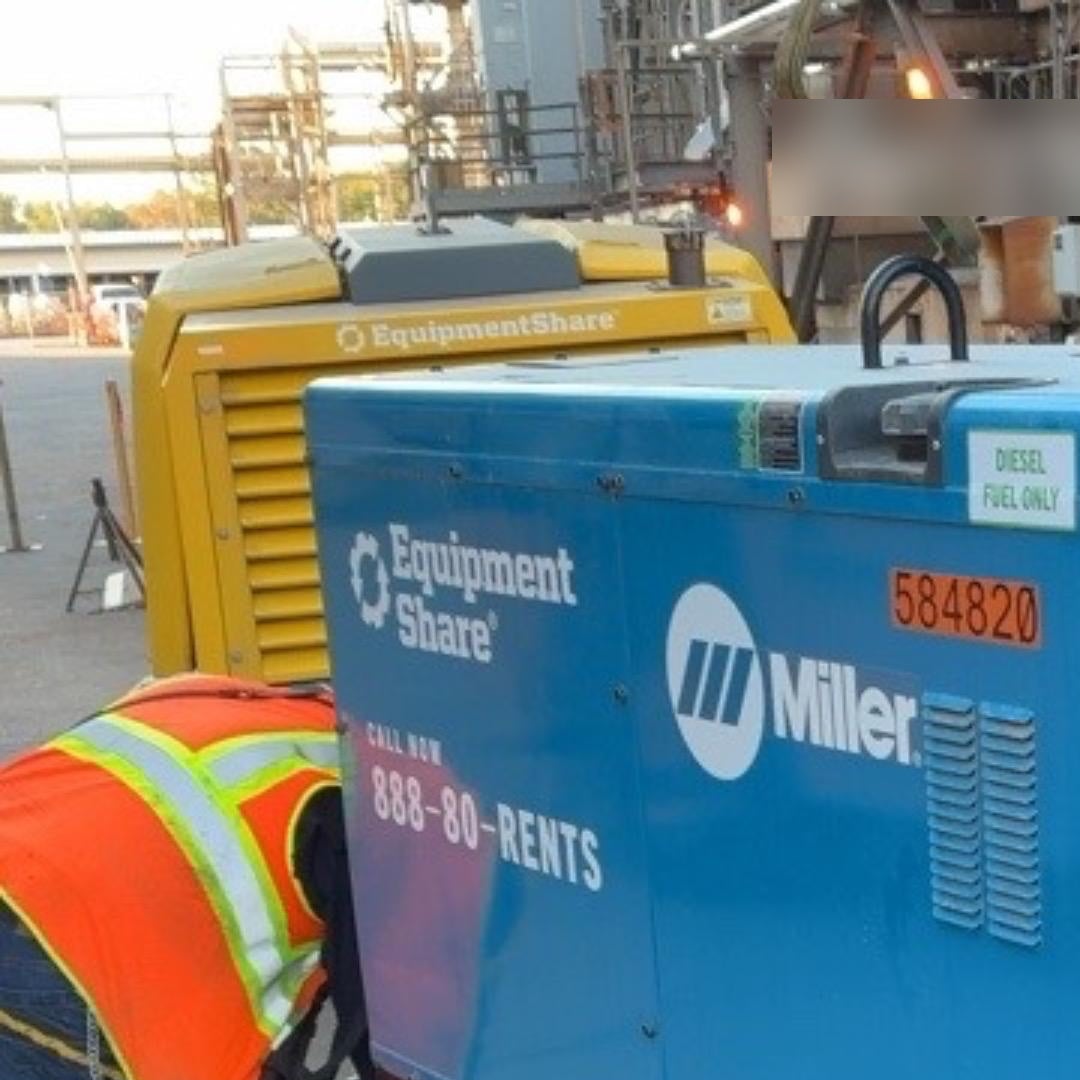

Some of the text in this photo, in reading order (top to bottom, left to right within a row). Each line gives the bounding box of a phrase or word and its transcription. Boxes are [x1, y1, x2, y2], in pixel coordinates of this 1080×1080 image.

[372, 310, 616, 350] EquipmentShare
[995, 447, 1046, 475] DIESEL
[984, 483, 1060, 513] FUEL ONLY
[389, 523, 577, 606] Equipment
[895, 572, 1039, 644] 584820
[366, 720, 442, 767] CALL NOW
[372, 765, 603, 892] 888-80-RENTS
